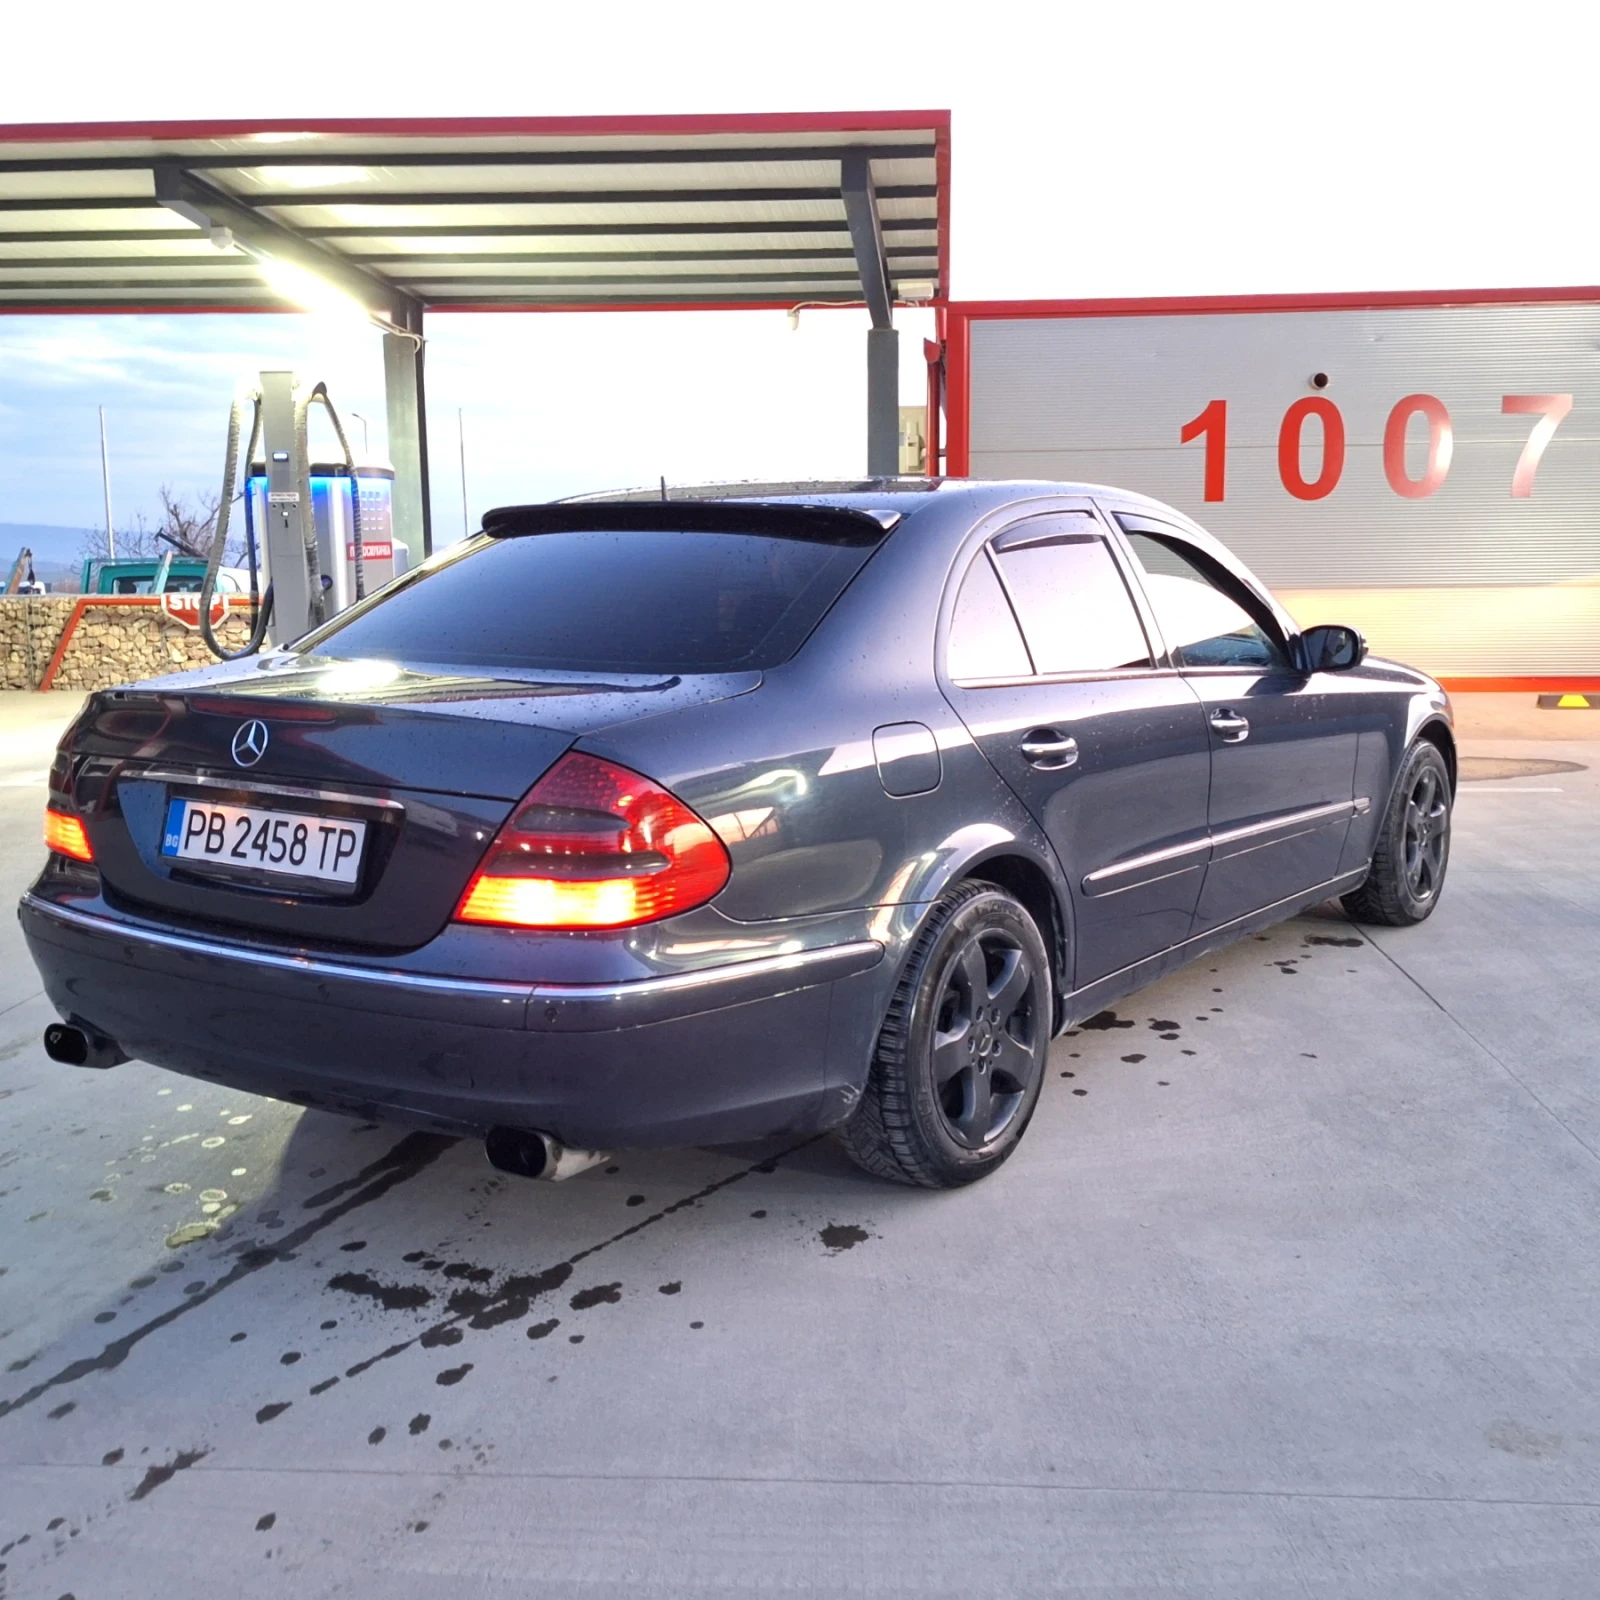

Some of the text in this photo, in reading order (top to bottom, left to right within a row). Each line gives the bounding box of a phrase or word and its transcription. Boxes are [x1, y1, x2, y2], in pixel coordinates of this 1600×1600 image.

[164, 833, 179, 848] BG
[184, 809, 356, 872] PB 2458 TP
